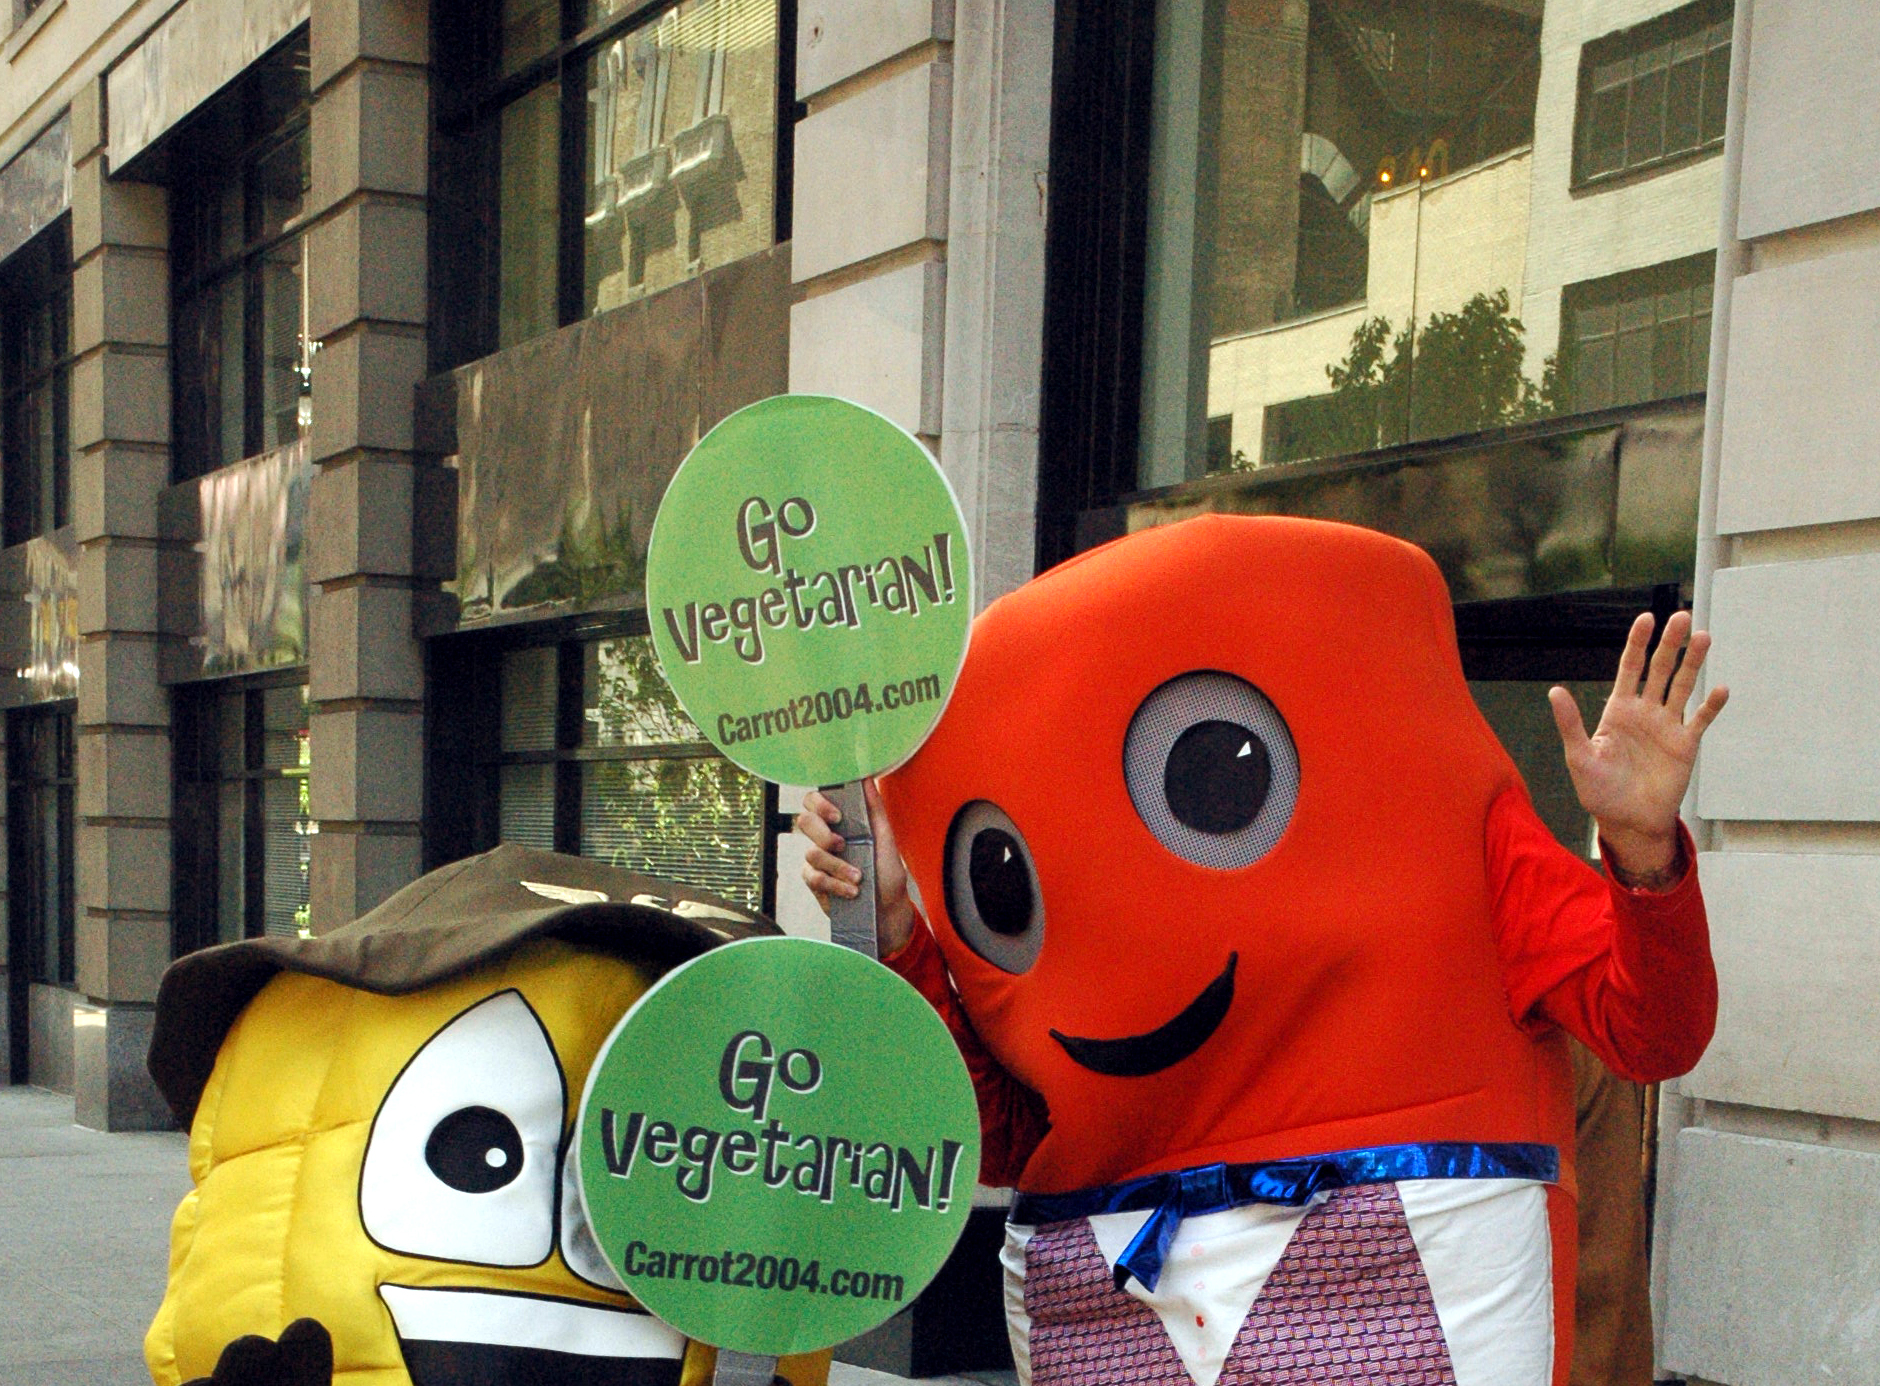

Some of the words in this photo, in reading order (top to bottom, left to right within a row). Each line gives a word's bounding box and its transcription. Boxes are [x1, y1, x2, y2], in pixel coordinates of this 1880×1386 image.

[737, 496, 817, 578] Go
[716, 672, 941, 746] Carrot2004.com
[718, 1029, 823, 1124] Go
[623, 1240, 905, 1302] Carrot2004.com
